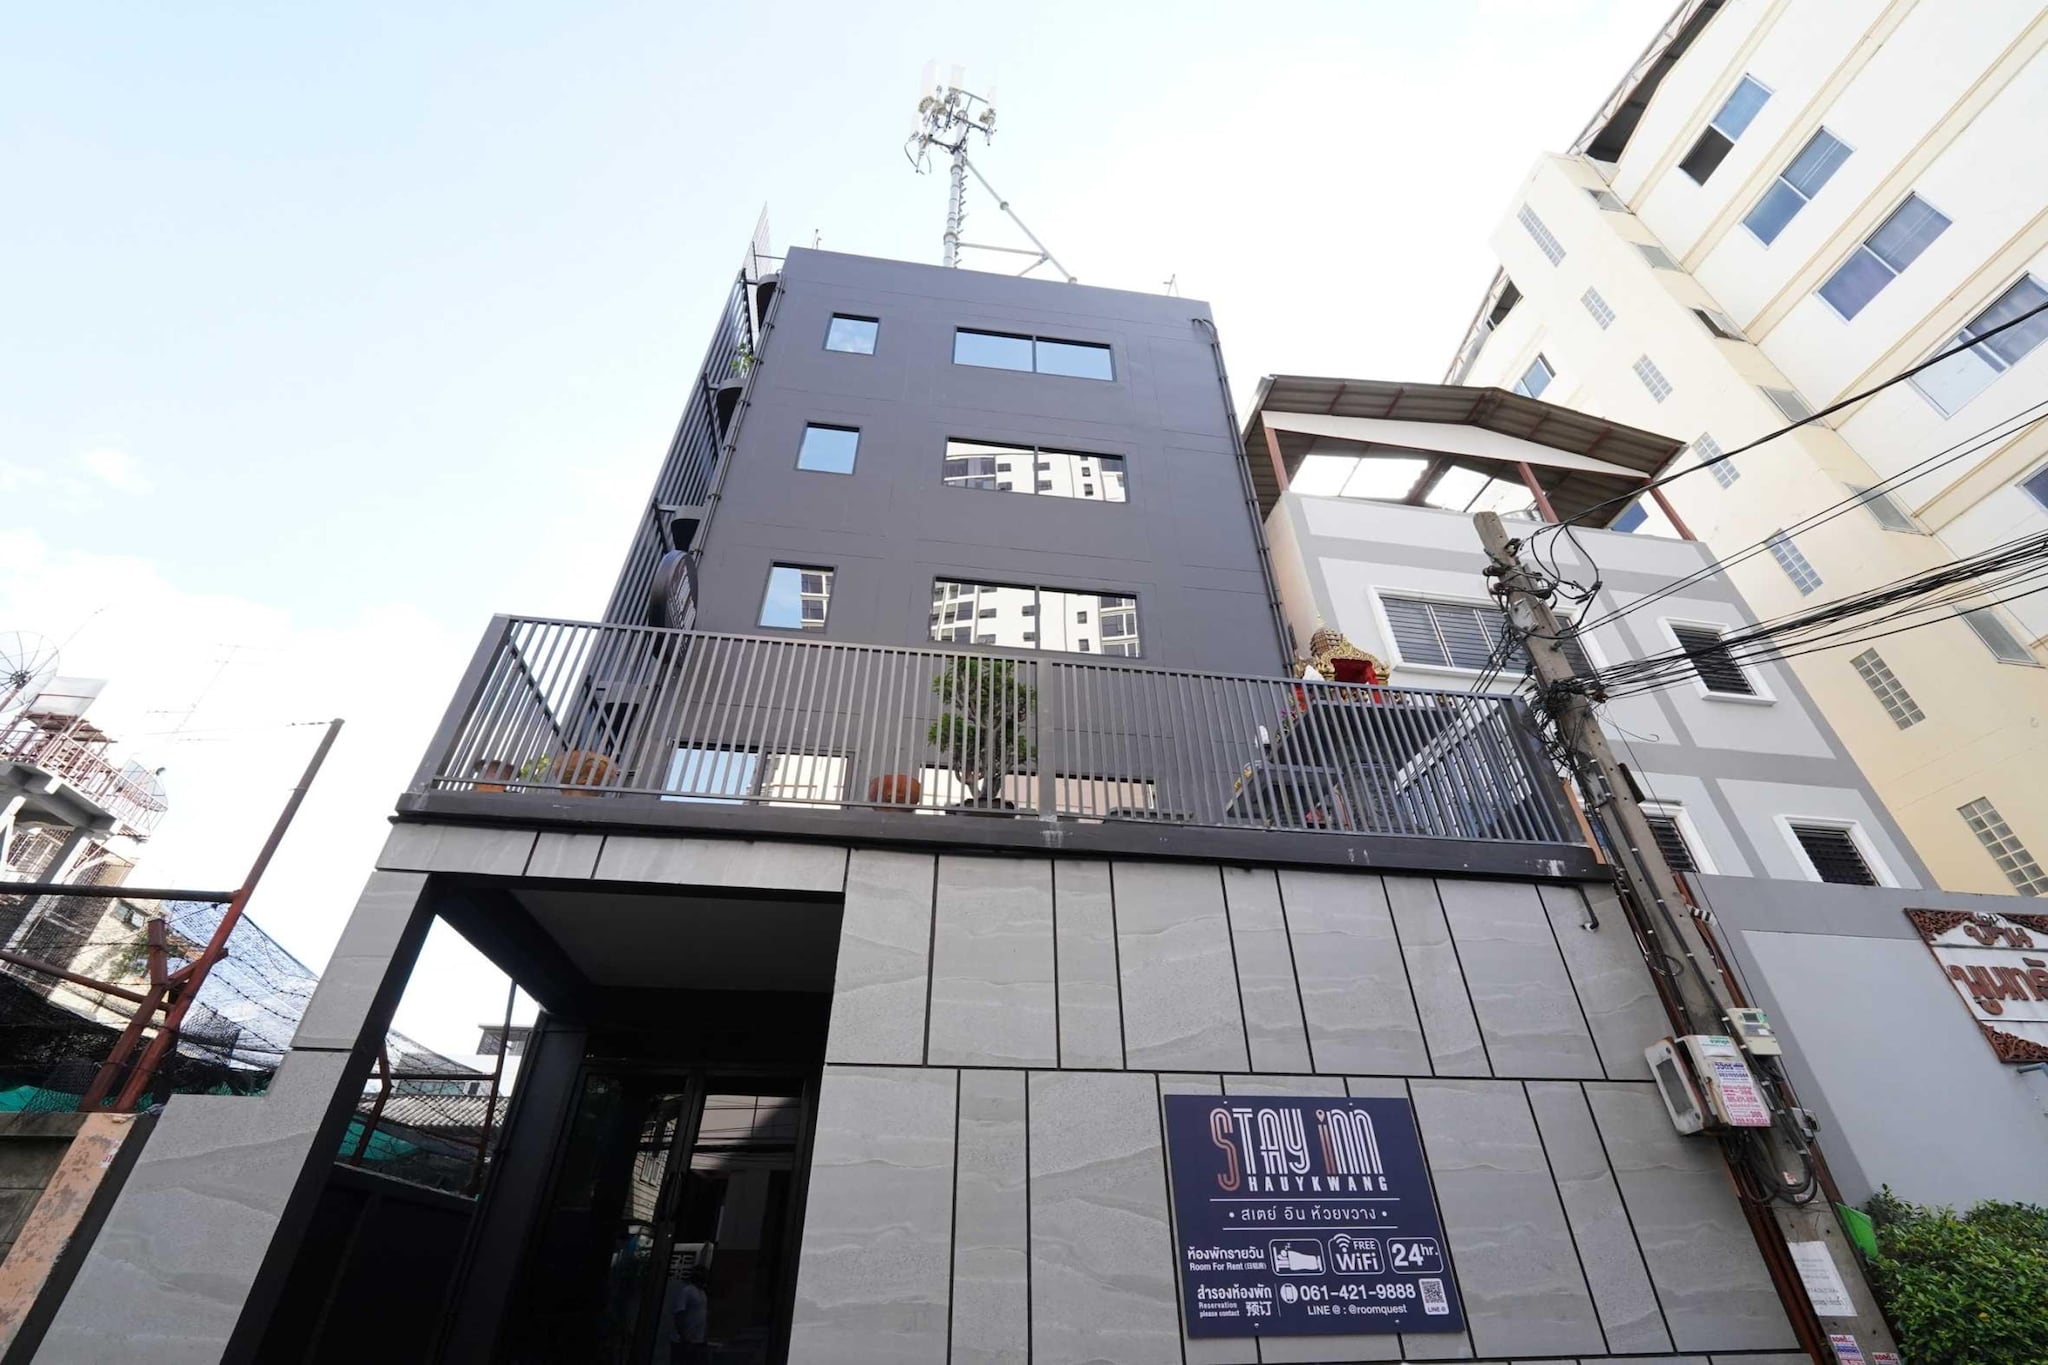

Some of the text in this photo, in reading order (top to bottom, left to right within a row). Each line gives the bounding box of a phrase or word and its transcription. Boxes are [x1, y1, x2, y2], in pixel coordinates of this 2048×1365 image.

[1248, 1176, 1388, 1191] HAUYKWANG
[1241, 1204, 1377, 1221] สเตย์ อิน ห้วยขวาง
[1353, 1241, 1377, 1250] FREE
[1187, 1246, 1265, 1260] ห้องพักรายวัน
[1189, 1262, 1211, 1271] Room
[1213, 1262, 1225, 1271] For
[1226, 1261, 1244, 1270] Rent
[1336, 1253, 1379, 1271] WiFi
[1197, 1283, 1273, 1300] สำรองห้องพัก
[1300, 1283, 1417, 1301] 061-421-9888
[1198, 1302, 1238, 1310] Reservation
[1307, 1305, 1331, 1316] LINE
[1349, 1303, 1408, 1317] @roomquest
